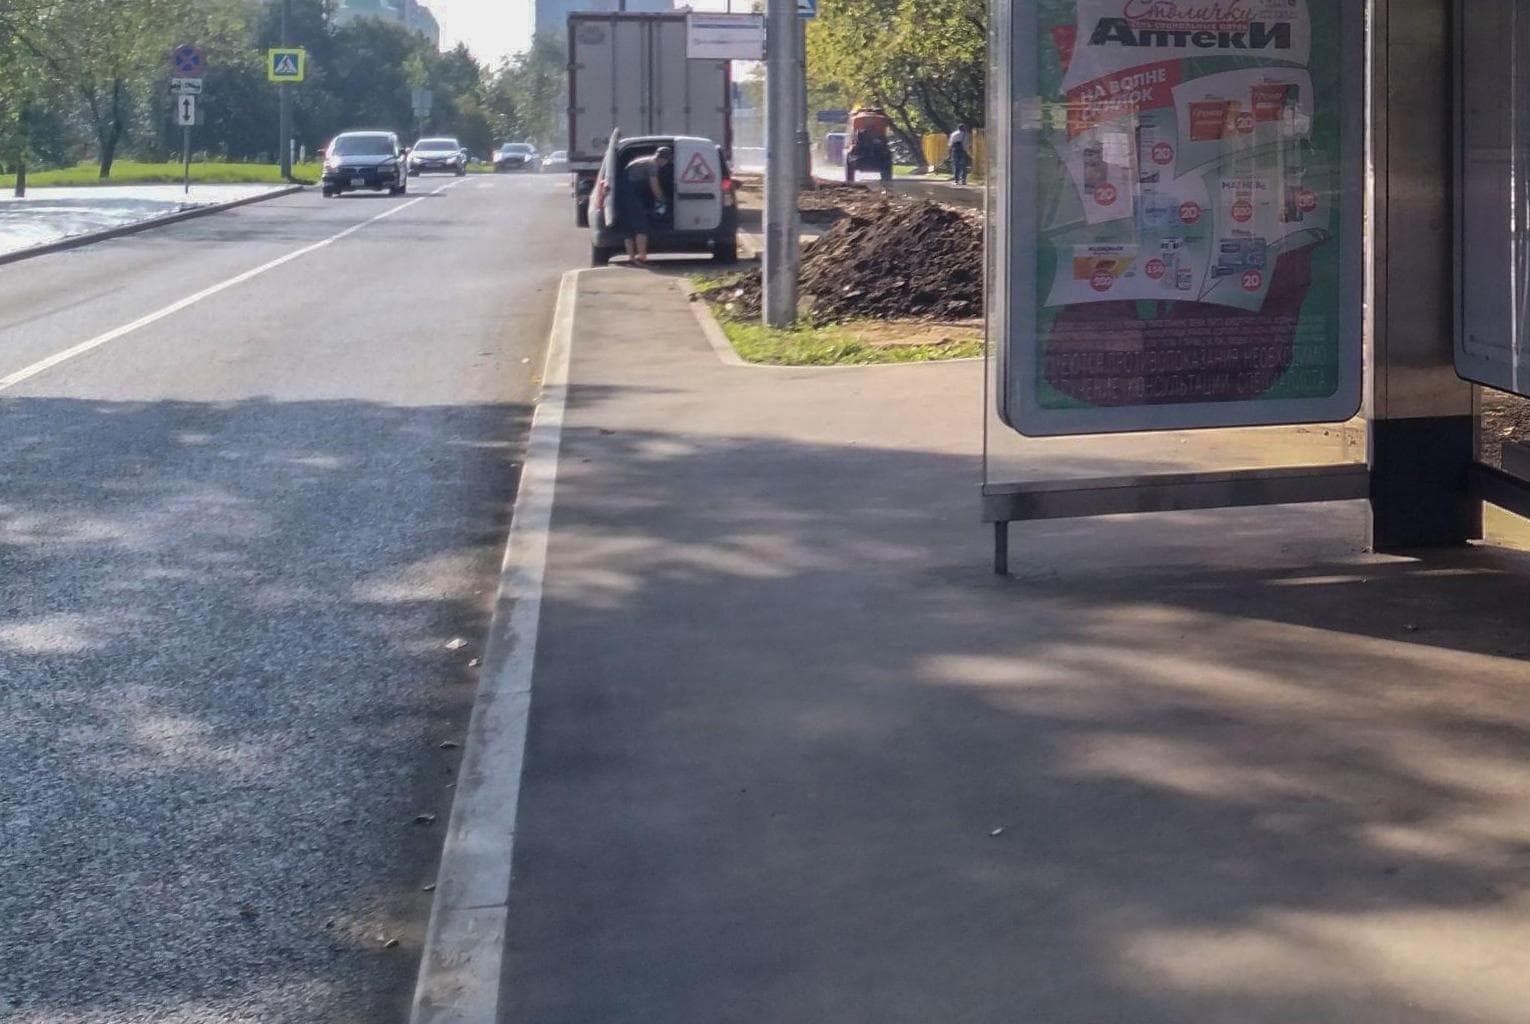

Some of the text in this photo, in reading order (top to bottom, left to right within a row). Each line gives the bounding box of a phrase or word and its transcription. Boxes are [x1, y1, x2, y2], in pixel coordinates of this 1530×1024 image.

[1080, 68, 1168, 104] НА ВОЛНЕ
[1080, 86, 1154, 121] СДОК
[1181, 207, 1198, 218] 20
[1243, 275, 1260, 287] 20
